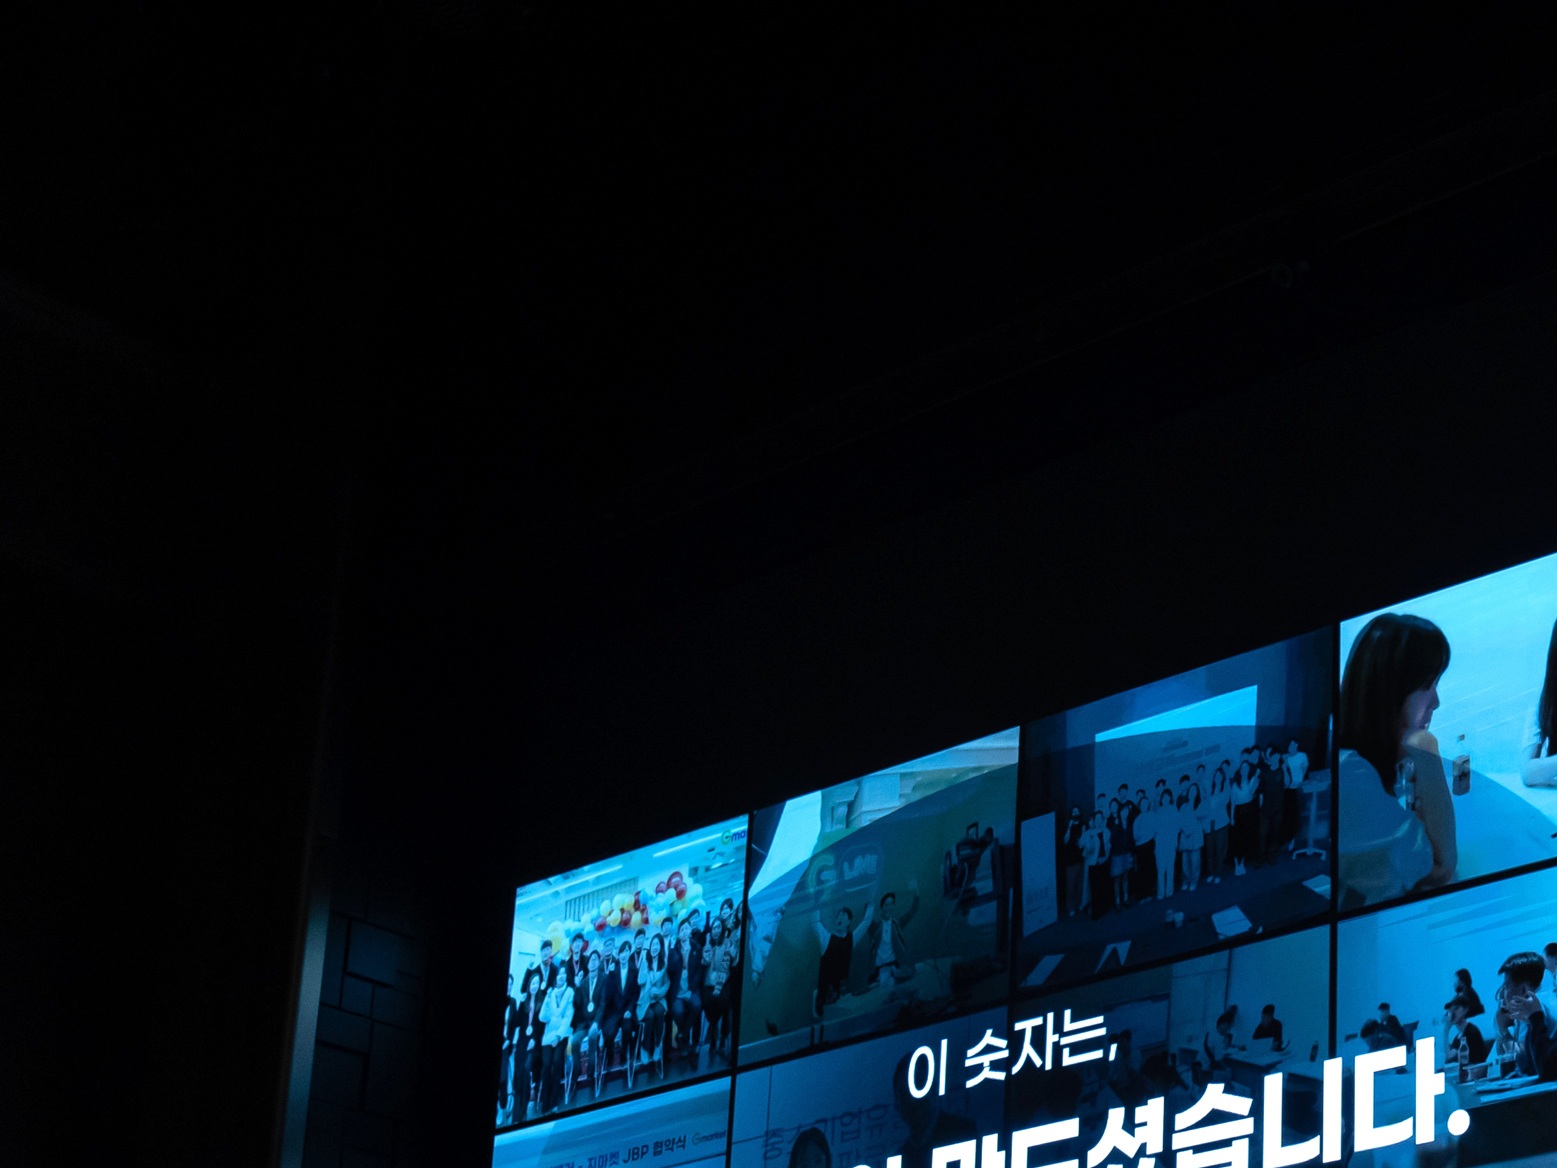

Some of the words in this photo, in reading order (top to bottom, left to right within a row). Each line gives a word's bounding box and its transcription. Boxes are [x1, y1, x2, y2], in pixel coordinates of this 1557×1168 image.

[908, 1038, 948, 1099] 이
[964, 1009, 1118, 1089] 숫자는,
[622, 1144, 650, 1164] JBP
[652, 1134, 687, 1157] 협약식
